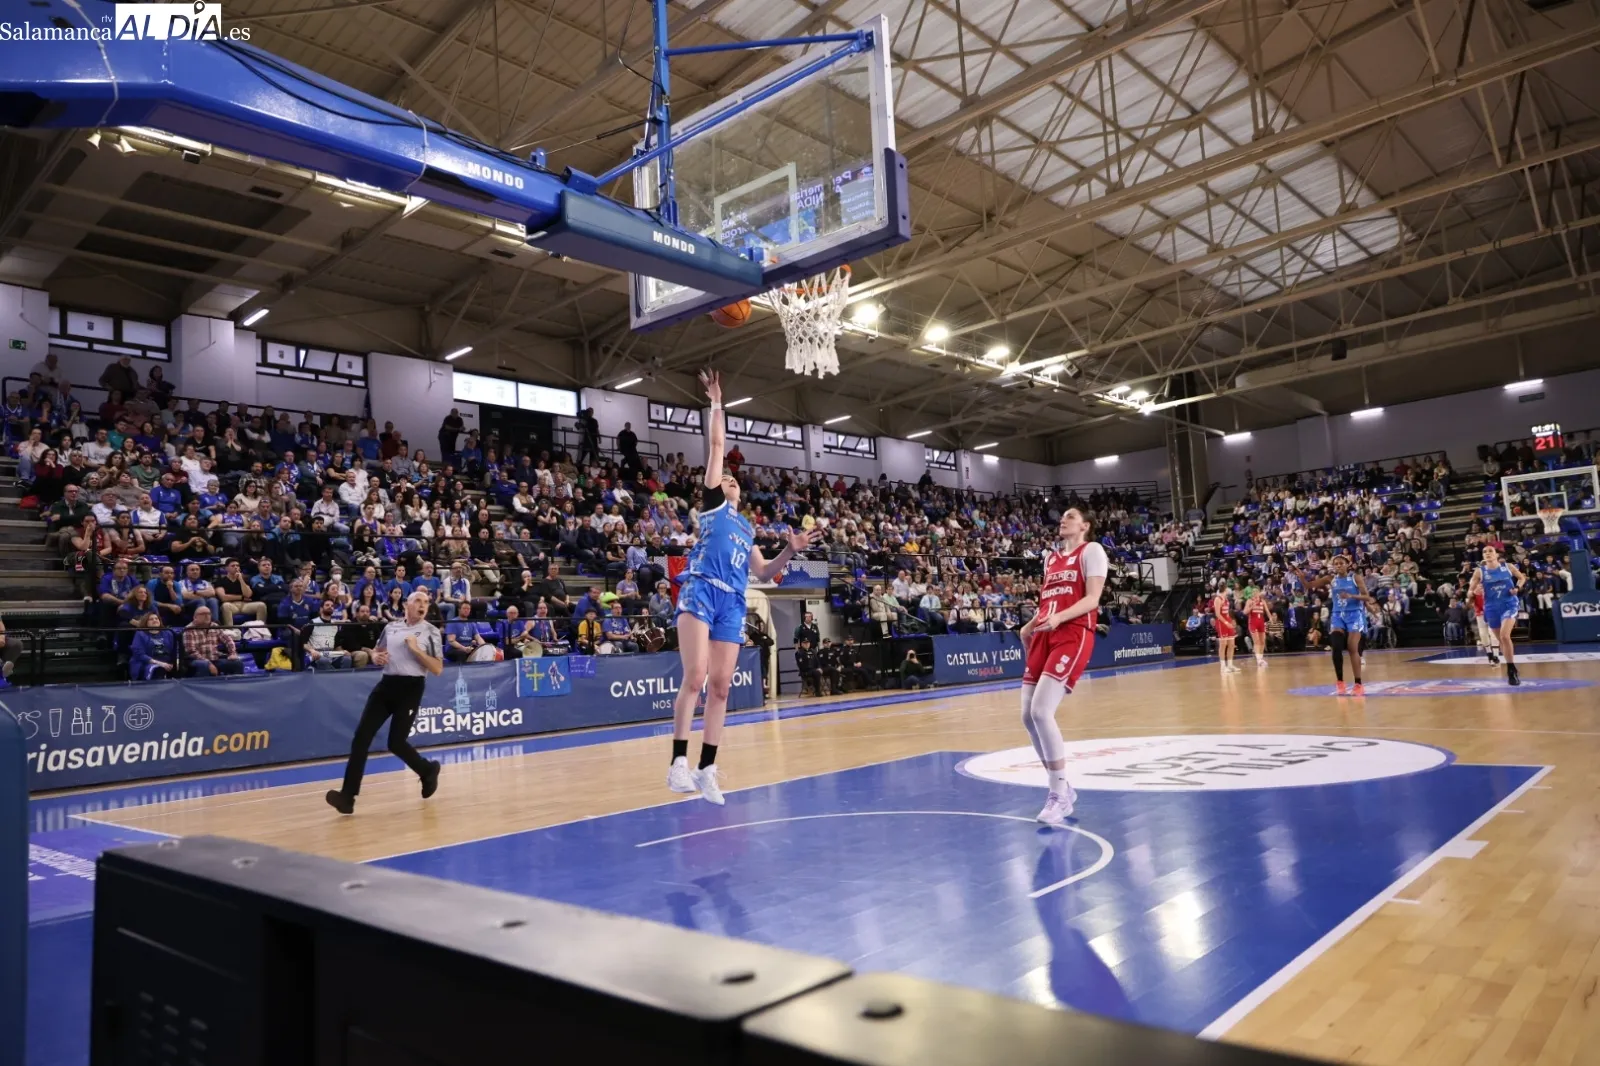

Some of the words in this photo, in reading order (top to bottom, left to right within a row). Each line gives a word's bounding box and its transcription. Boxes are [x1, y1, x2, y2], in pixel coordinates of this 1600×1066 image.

[467, 161, 524, 190] MONDO
[653, 230, 695, 255] MONDO
[1535, 436, 1555, 451] 21
[730, 547, 747, 569] 10
[946, 651, 989, 666] CASTILLA
[991, 650, 998, 665] Y
[1000, 645, 1021, 662] LEÓN
[610, 676, 679, 698] CASTILL
[652, 700, 672, 710] NOS
[27, 730, 270, 773] riasavenida.com
